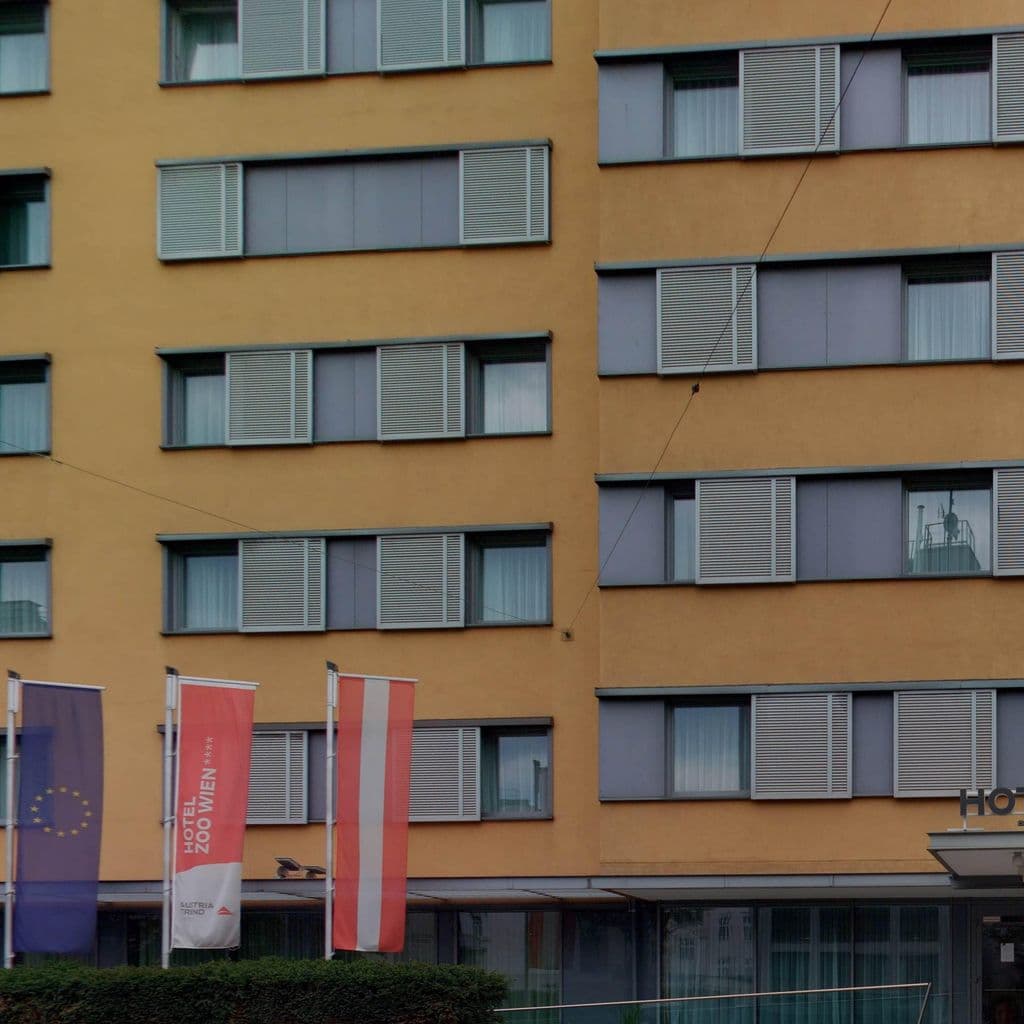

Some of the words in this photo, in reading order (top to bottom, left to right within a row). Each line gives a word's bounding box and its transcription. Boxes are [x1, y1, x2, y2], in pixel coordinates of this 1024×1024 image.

[198, 768, 217, 813] WIEN
[183, 796, 196, 854] HOTEL
[195, 817, 212, 854] ZOO
